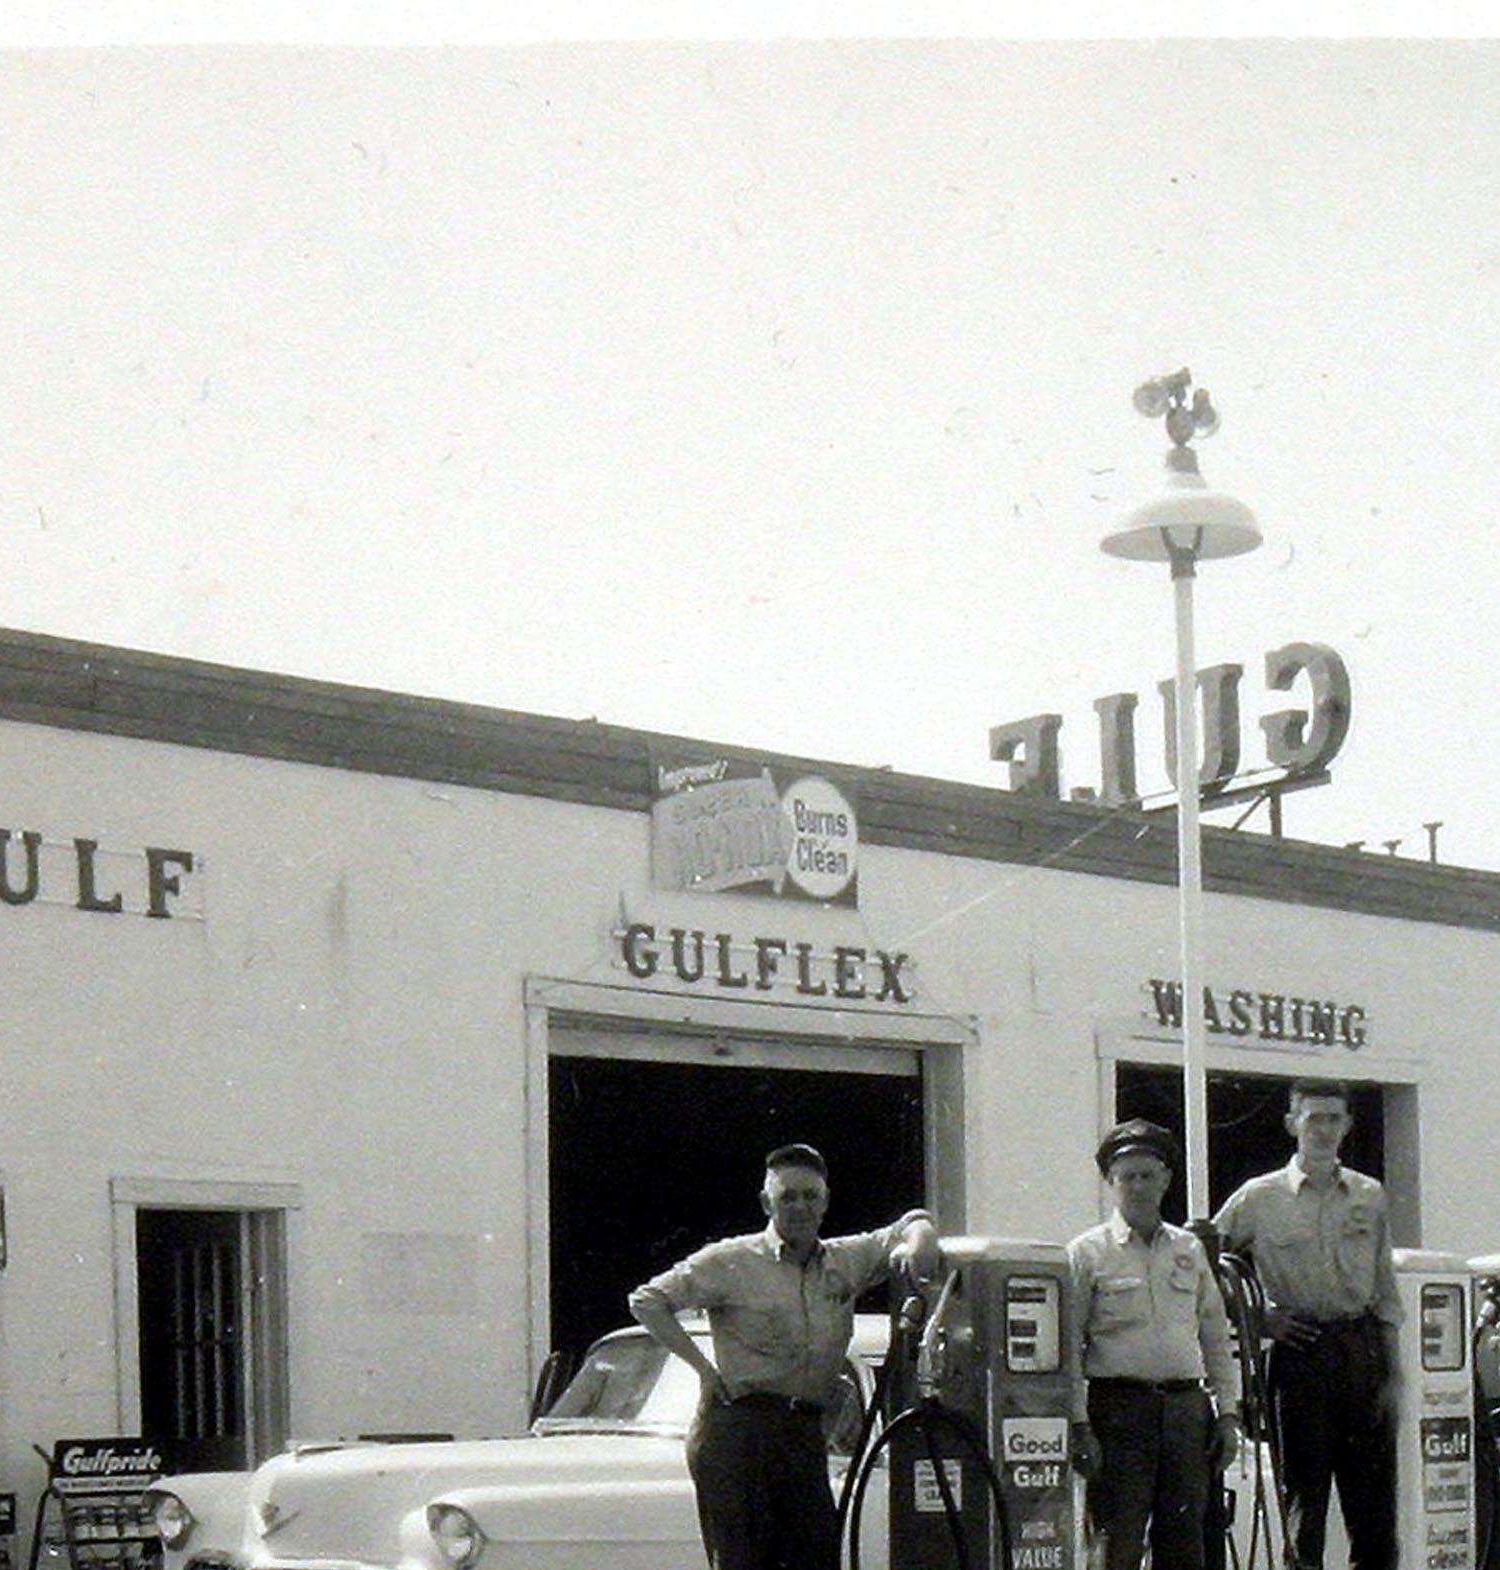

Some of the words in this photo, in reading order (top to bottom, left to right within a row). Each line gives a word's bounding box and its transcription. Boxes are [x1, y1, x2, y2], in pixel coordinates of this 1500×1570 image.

[794, 798, 848, 838] Burns
[796, 838, 848, 875] Clean
[620, 922, 913, 1004] GULFLEX
[1147, 978, 1368, 1051] WASHING
[1009, 1432, 1063, 1454] Good
[63, 1446, 163, 1475] Gulfpride
[1013, 1465, 1061, 1487] Gulf
[1011, 1546, 1063, 1570] VALUE
